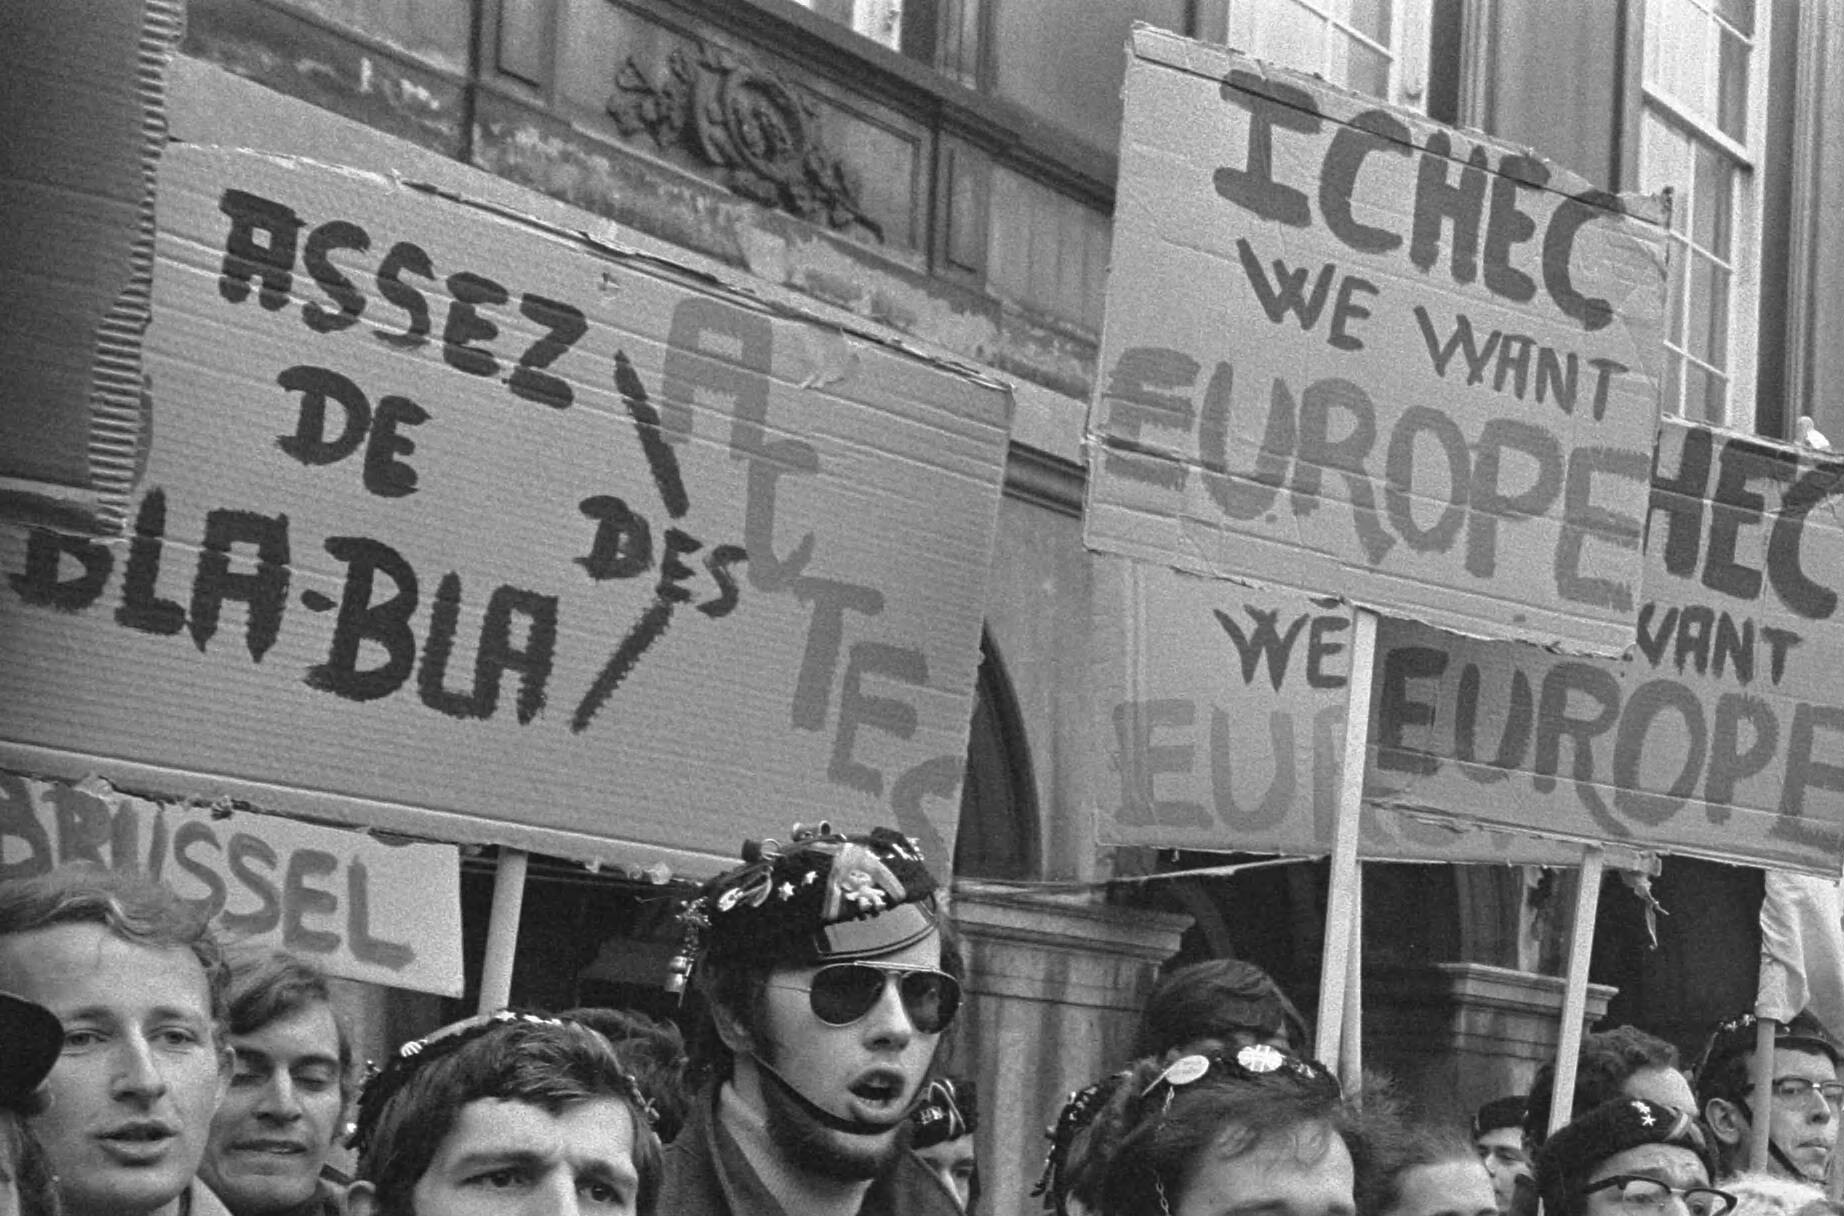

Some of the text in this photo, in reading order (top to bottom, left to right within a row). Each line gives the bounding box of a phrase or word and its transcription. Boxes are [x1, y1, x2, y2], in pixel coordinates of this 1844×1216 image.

[219, 189, 588, 407] ASSEZ
[1213, 68, 1625, 332] ICHEC
[1236, 237, 1632, 422] WE WANT
[276, 364, 430, 498] DE
[1099, 346, 1653, 613] EUROPE
[8, 487, 559, 725] BLA-BLA
[573, 494, 749, 618] DES
[1212, 604, 1352, 692] WE
